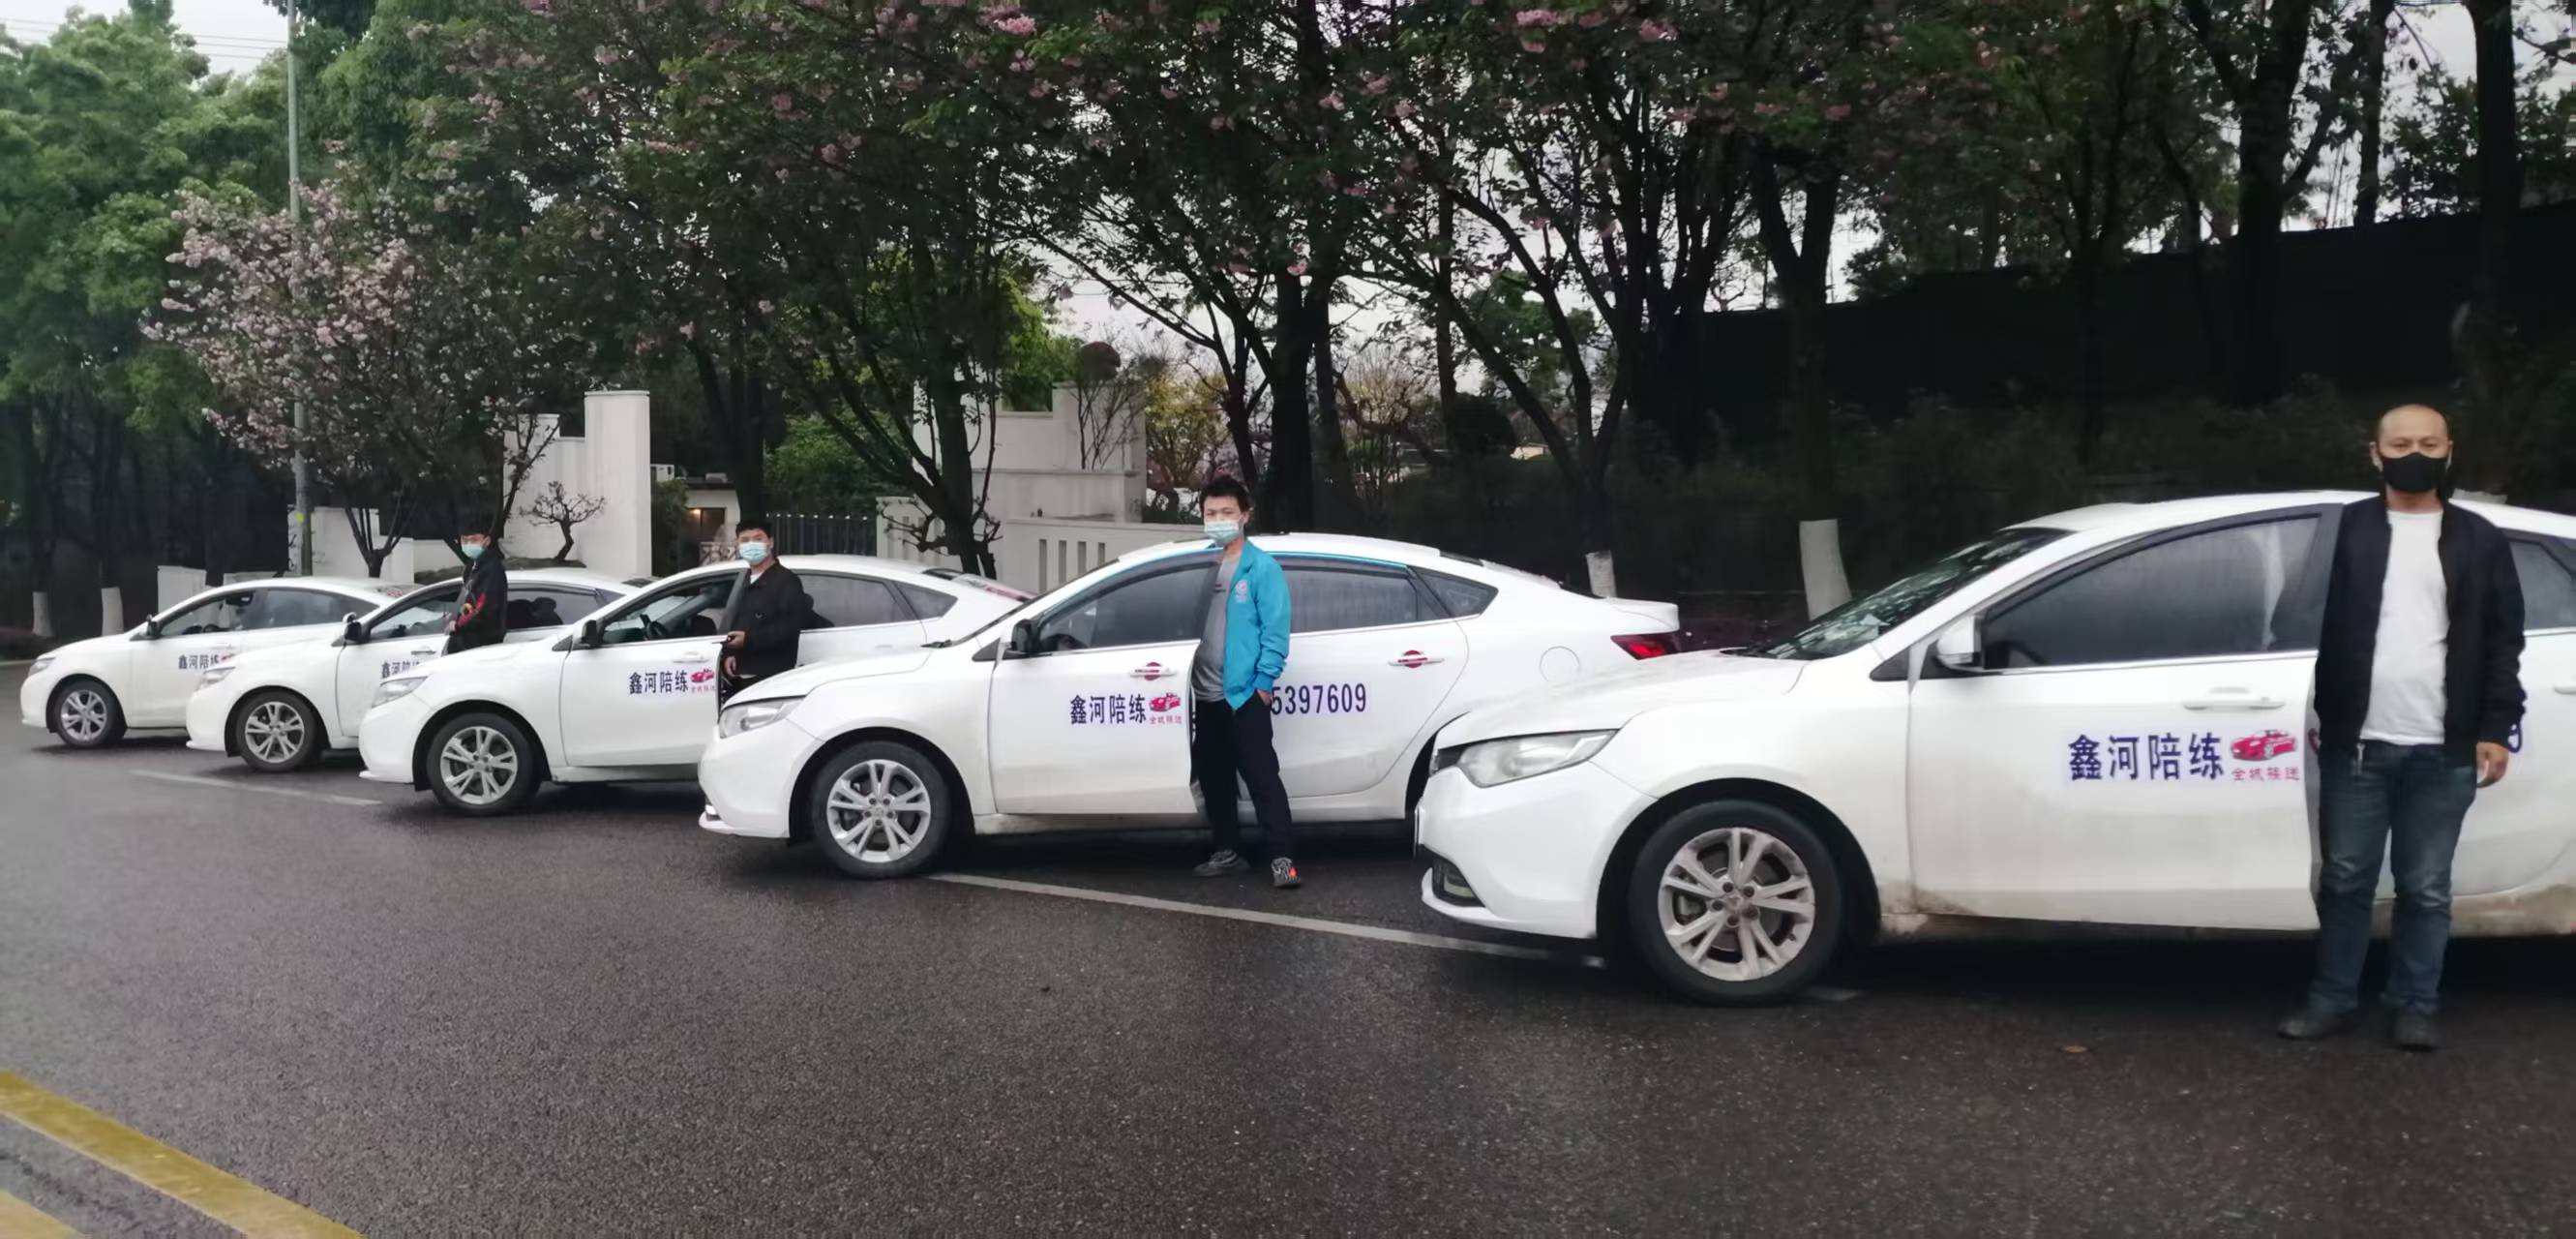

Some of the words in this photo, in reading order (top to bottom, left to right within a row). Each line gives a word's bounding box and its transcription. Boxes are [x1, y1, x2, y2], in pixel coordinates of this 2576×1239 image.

[629, 670, 688, 694] 鑫河陪练
[1070, 694, 1146, 724] 鑫河陪练
[1271, 683, 1366, 715] 5397609
[2069, 733, 2224, 780] 鑫河陪练
[2232, 768, 2300, 781] 全城接送
